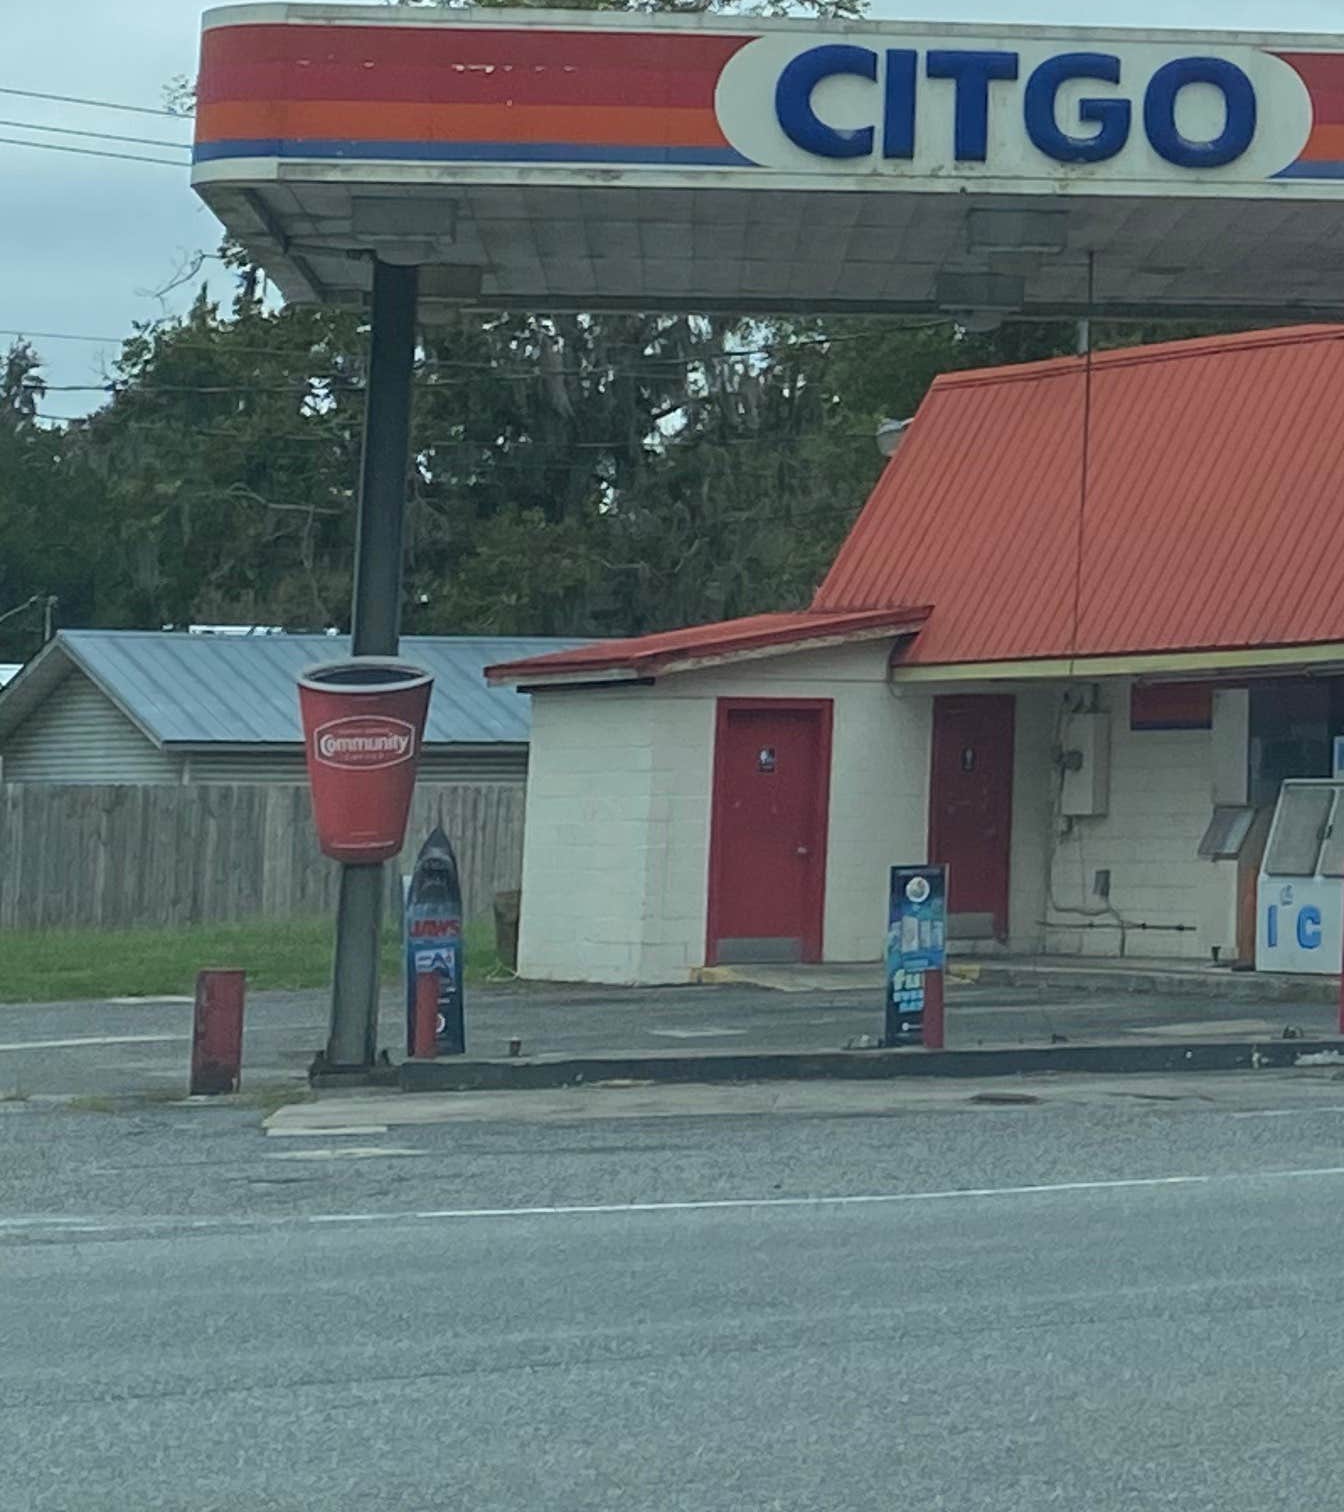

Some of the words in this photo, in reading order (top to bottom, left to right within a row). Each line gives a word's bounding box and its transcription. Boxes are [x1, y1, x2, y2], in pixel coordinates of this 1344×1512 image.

[774, 43, 1258, 169] CITGO
[319, 733, 409, 756] Community
[893, 968, 925, 990] fu
